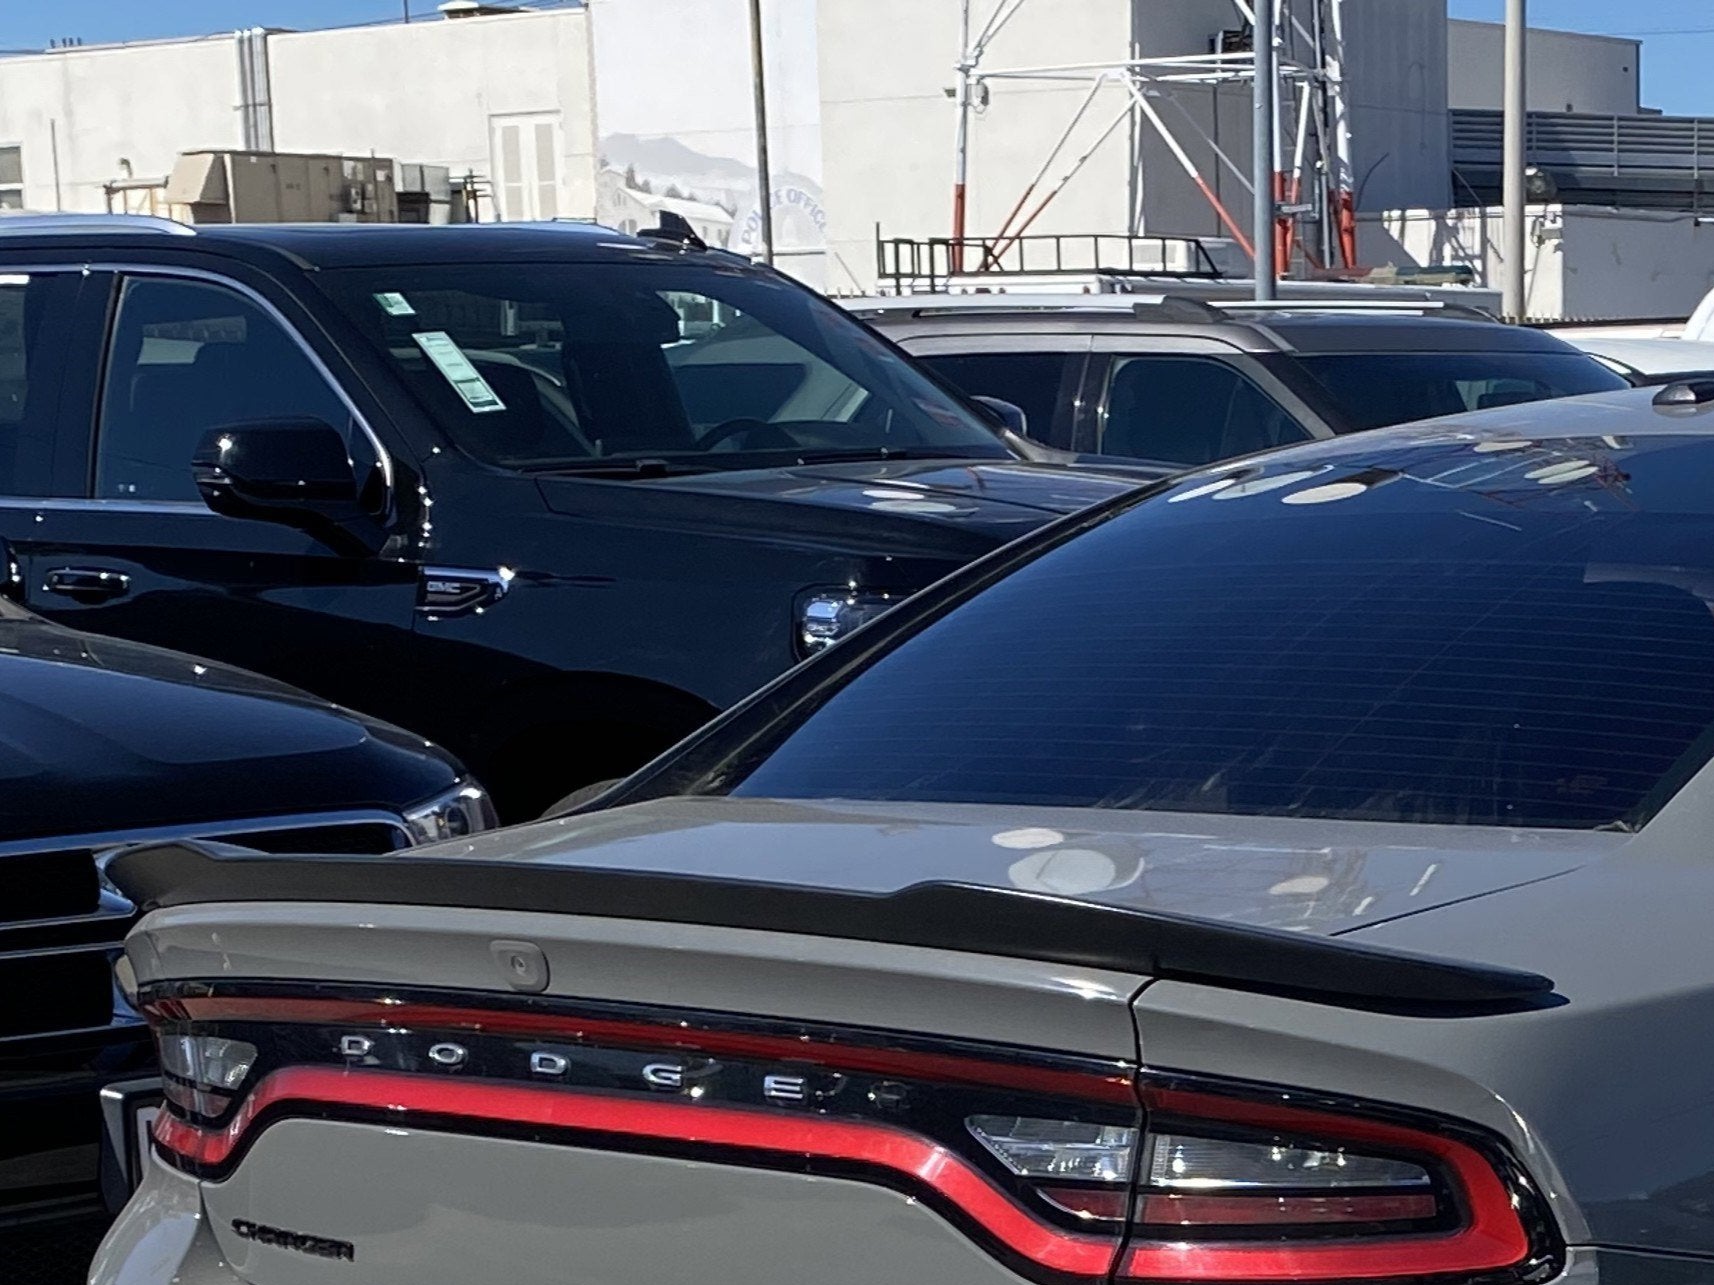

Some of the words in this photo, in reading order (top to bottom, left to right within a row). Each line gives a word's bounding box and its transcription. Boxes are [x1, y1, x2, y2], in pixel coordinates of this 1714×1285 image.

[741, 188, 784, 245] POLE
[340, 1034, 804, 1100] DODGE
[230, 1217, 355, 1263] CHARGER
